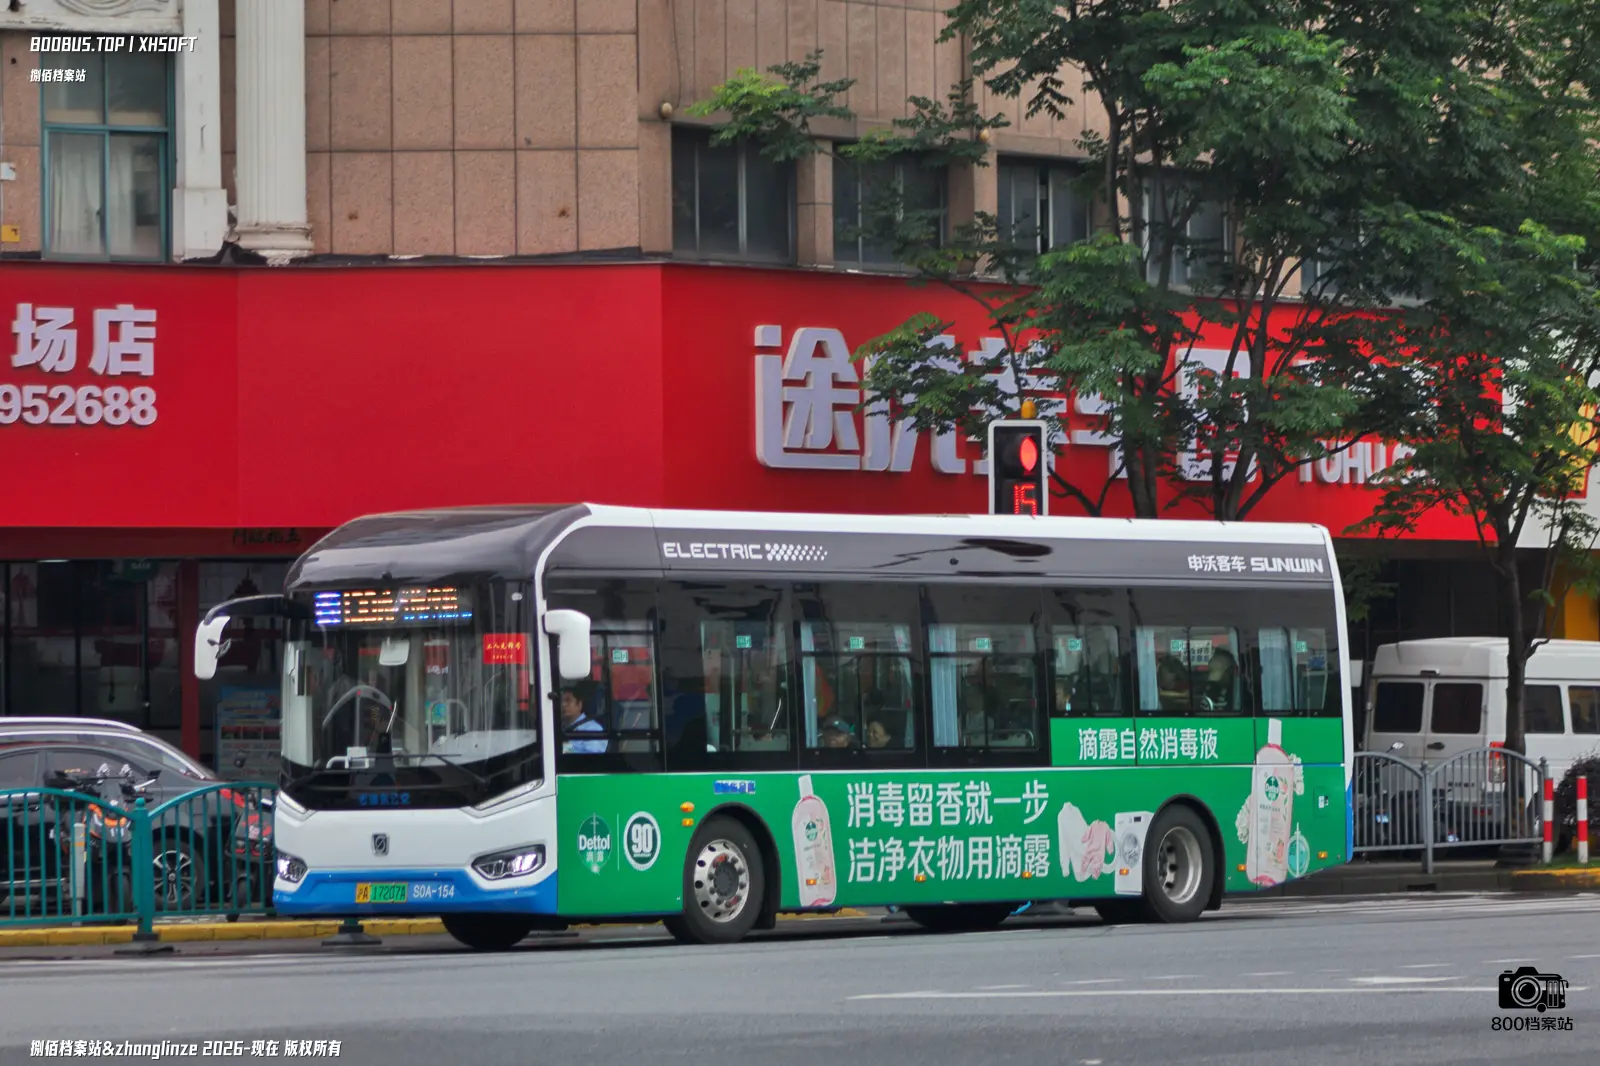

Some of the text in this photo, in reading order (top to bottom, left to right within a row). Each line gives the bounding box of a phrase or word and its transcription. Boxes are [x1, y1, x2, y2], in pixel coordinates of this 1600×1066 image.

[11, 302, 157, 376] 场店
[0, 384, 158, 426] 952688
[663, 542, 763, 559] ELECTRIC
[1187, 555, 1324, 573] 申沃客车 SUNWIN
[1078, 728, 1219, 760] 滴露自然消毒液
[847, 780, 1049, 828] 消毒留香就一步
[579, 834, 611, 851] Dettol
[847, 833, 1050, 883] 洁净衣物用滴露
